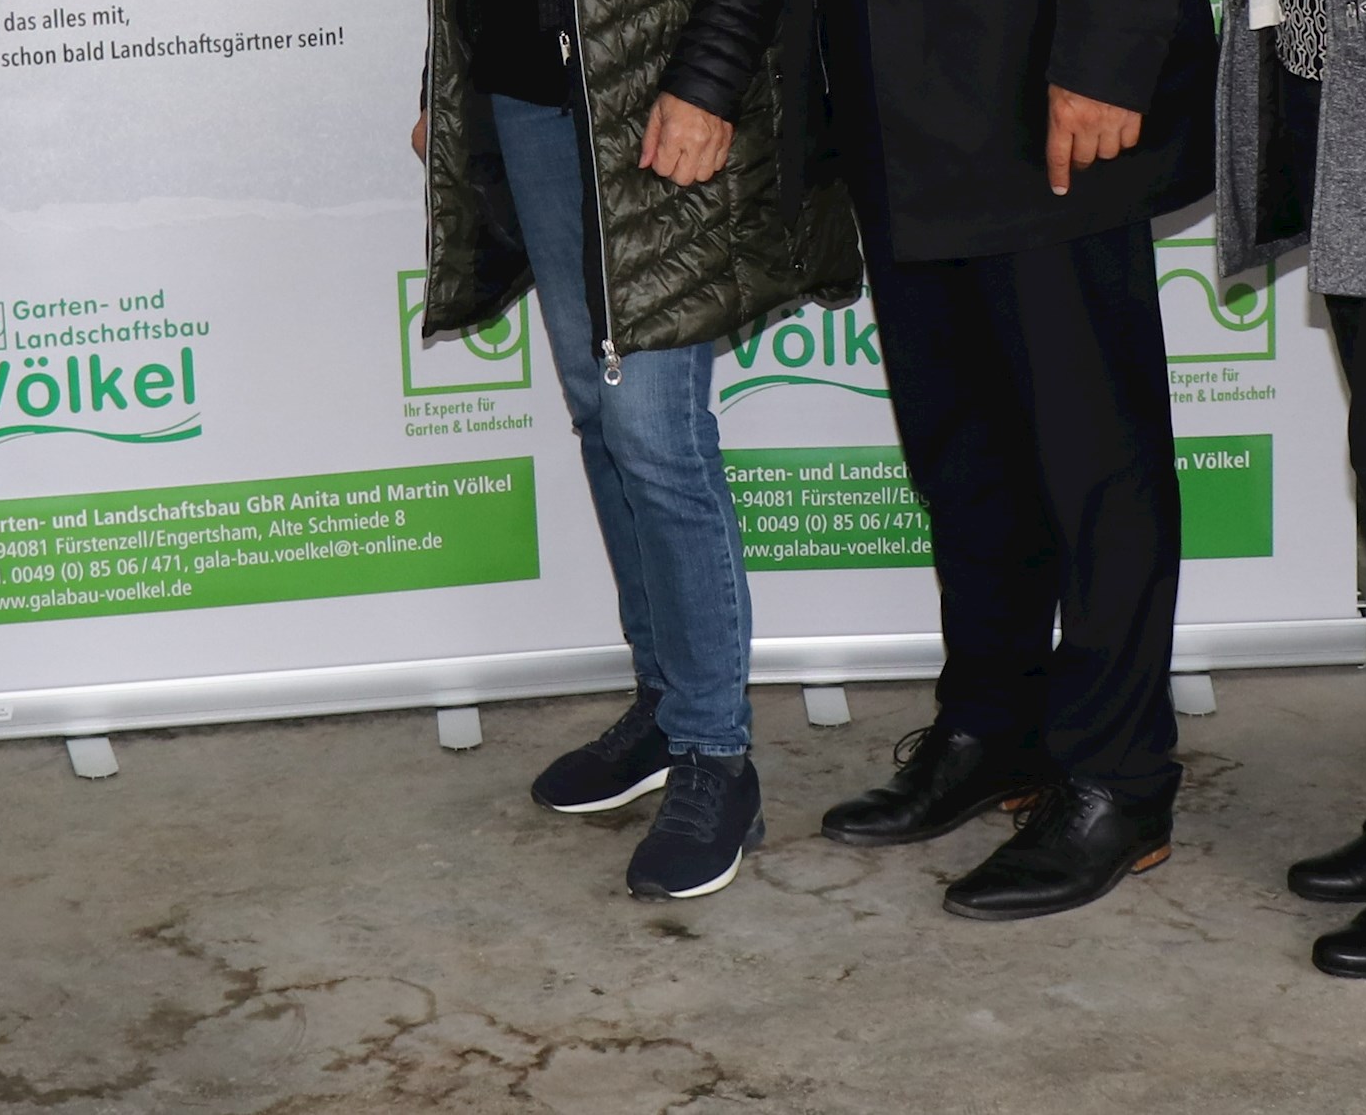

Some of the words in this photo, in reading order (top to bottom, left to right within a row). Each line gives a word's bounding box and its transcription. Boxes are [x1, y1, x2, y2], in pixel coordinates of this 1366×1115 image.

[4, 12, 36, 31] das
[43, 9, 86, 28] alles
[93, 6, 129, 25] mit,
[2, 47, 55, 66] schon
[64, 42, 103, 62] bald
[111, 34, 292, 58] Landschaftsgärtner
[299, 27, 343, 47] sein!
[13, 300, 108, 319] Garten-
[120, 290, 164, 311] und
[16, 321, 209, 349] Landschaftsbau
[725, 308, 881, 369] Völk
[1170, 370, 1217, 387] Experte
[1222, 368, 1240, 382] für
[1198, 389, 1206, 402] &
[1211, 385, 1276, 402] Landschaft
[405, 403, 421, 416] Ihr
[426, 401, 474, 419] Experte
[477, 398, 495, 418] für
[406, 421, 449, 436] Garten
[453, 420, 462, 433] &
[467, 415, 533, 431] Landschaft
[724, 466, 792, 482] Garten-
[800, 463, 832, 480] und
[1193, 450, 1250, 470] Völkel
[53, 510, 87, 528] und
[95, 501, 239, 525] Landschaftsbau
[247, 495, 284, 512] GbR
[291, 491, 339, 509] Anita
[347, 486, 380, 504] und
[388, 482, 448, 500] Martin
[454, 475, 511, 494] Völkel
[56, 526, 261, 553] Fürstenzell/Engertsham,
[269, 520, 302, 536] Alte
[309, 512, 389, 533] Schmiede
[395, 510, 405, 526] 8
[757, 516, 799, 532] 0049
[806, 515, 827, 533] (0)
[834, 514, 853, 530] 85
[12, 565, 54, 583] 0049
[61, 562, 83, 581] (0)
[90, 560, 110, 577] 85
[194, 535, 442, 572] gala-bau.voelkel@t-online.de
